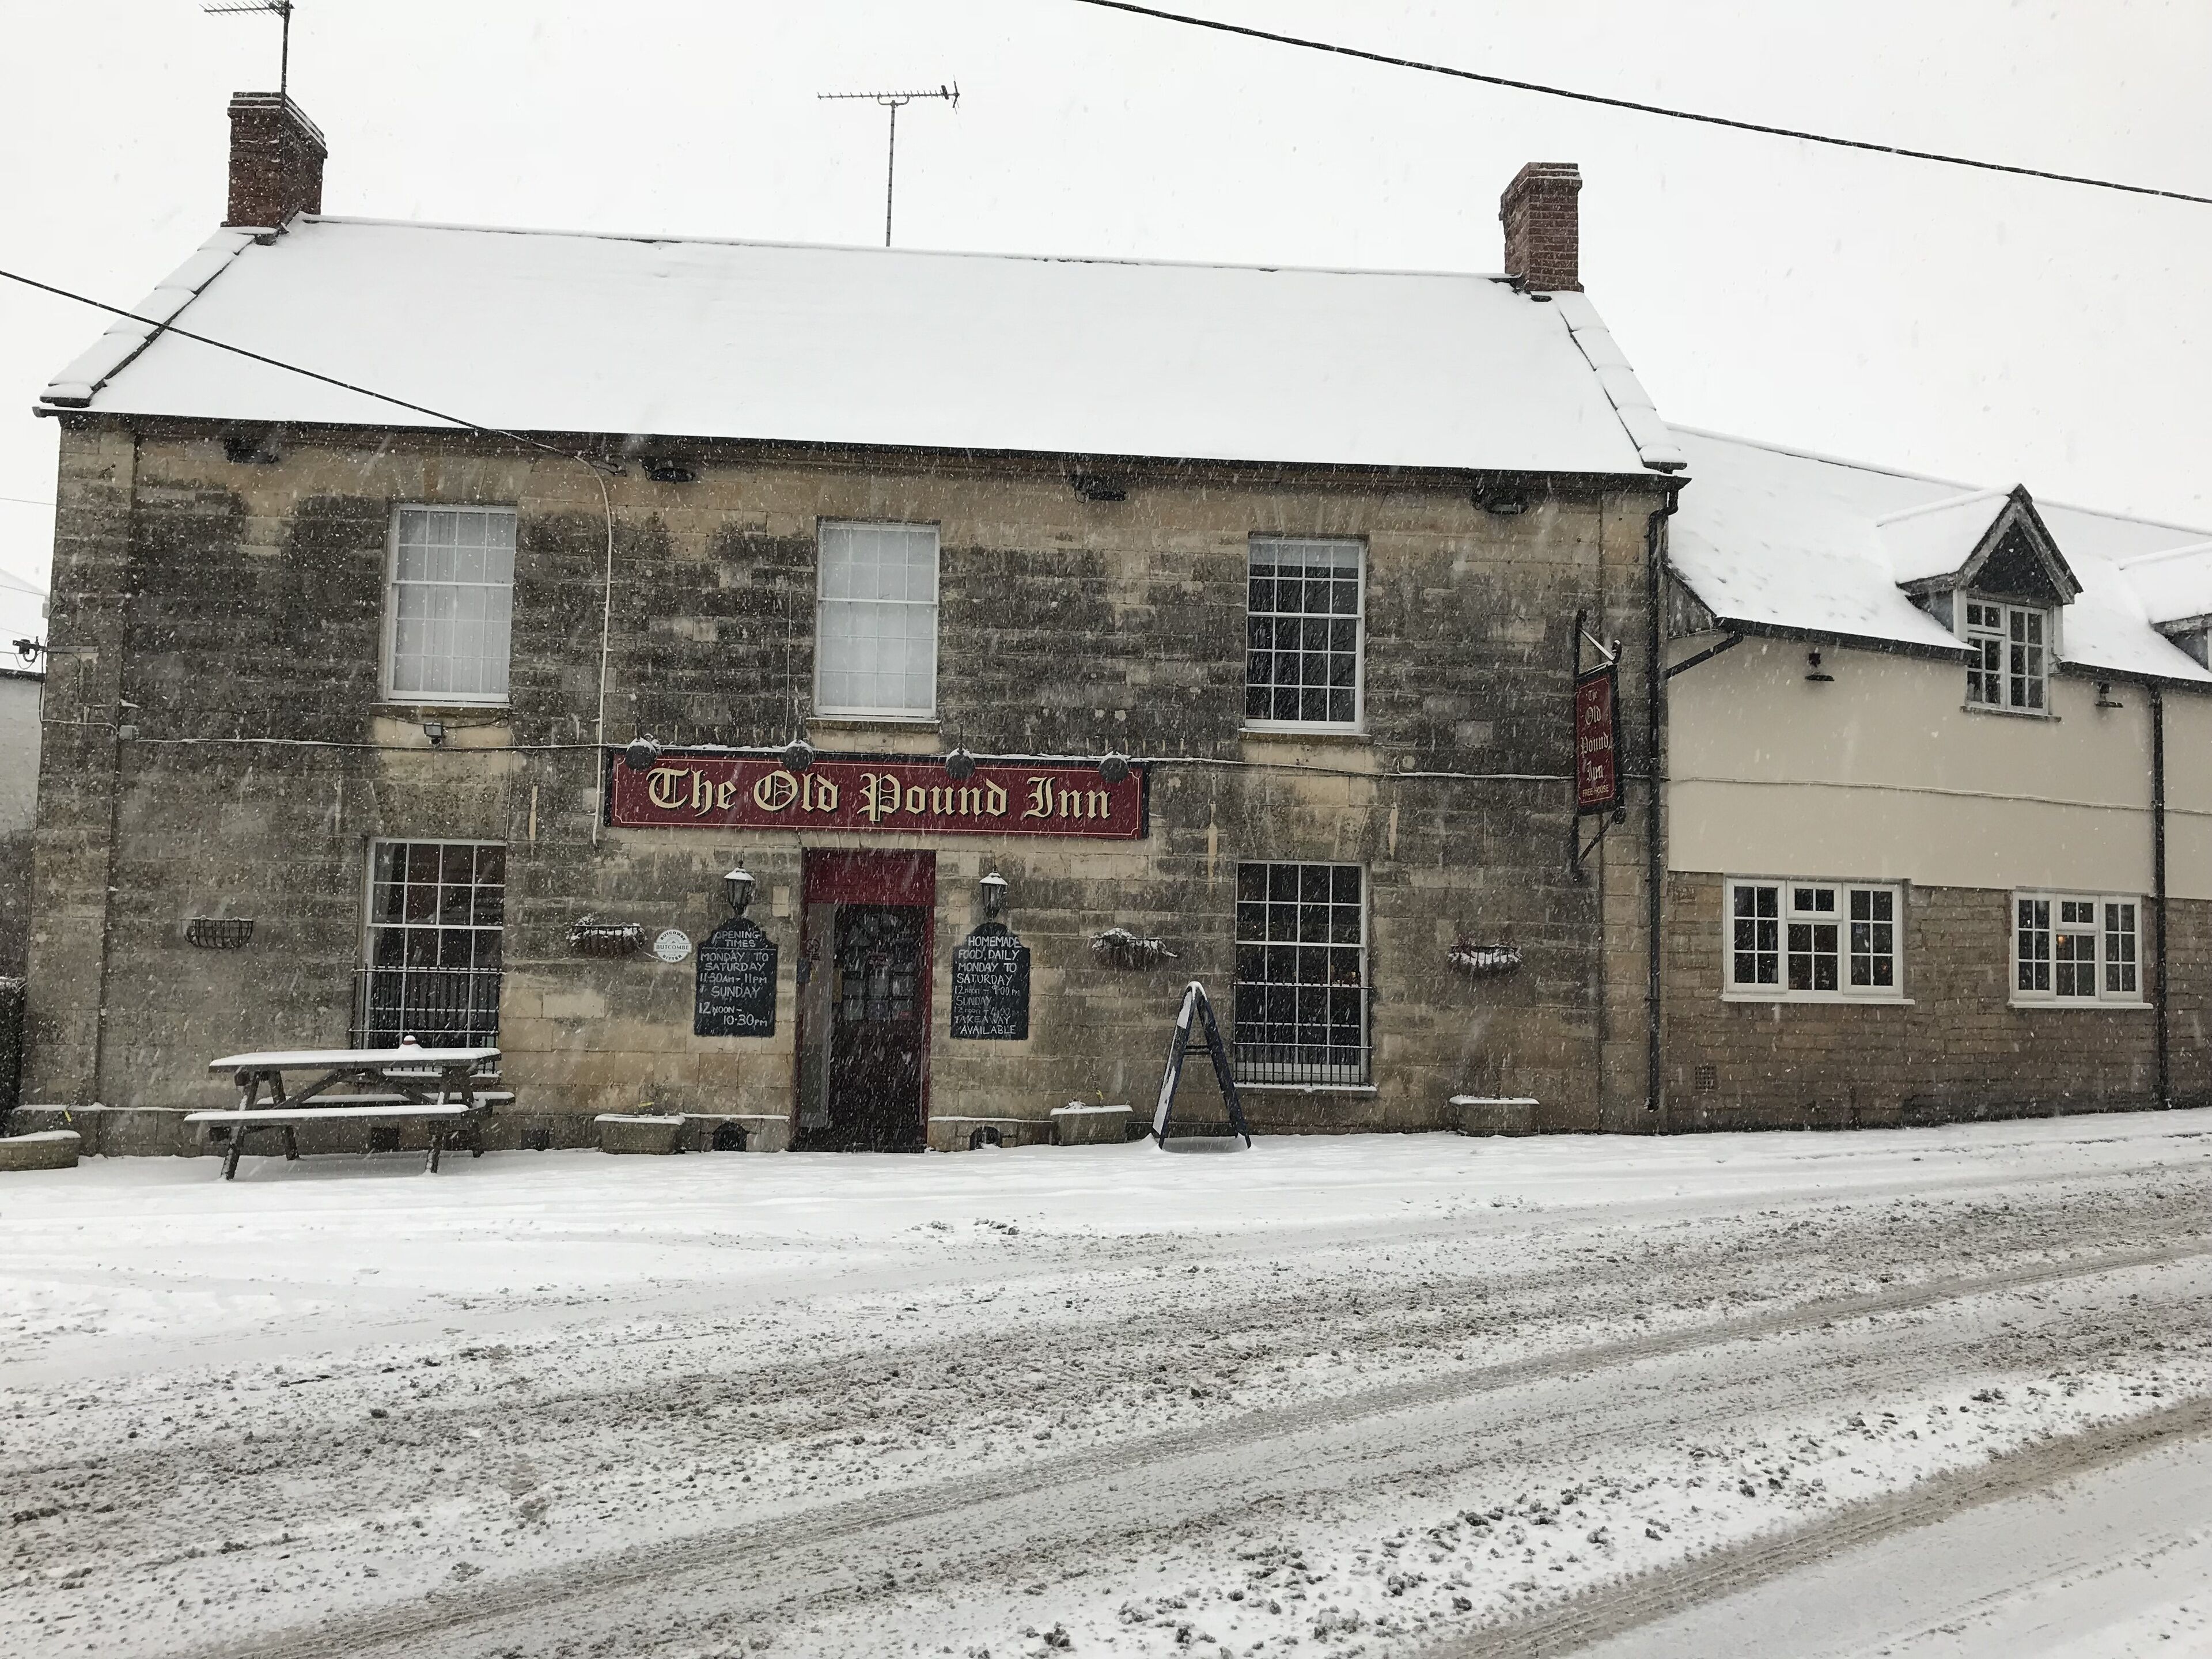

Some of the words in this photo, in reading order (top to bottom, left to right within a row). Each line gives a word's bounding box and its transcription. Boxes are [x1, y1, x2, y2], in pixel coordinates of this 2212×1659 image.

[1585, 705, 1601, 725] Old
[1580, 732, 1609, 758] Pound
[1586, 760, 1604, 781] Inn
[646, 768, 737, 817] The
[753, 770, 839, 813] Old
[857, 773, 1007, 821] Pound
[1024, 777, 1111, 819] Inn
[1582, 787, 1593, 797] FREE
[1594, 784, 1609, 794] HOUSE
[660, 931, 686, 941] BUTCOMBE
[715, 930, 760, 940] OPENING
[725, 940, 756, 948] TIMES
[968, 936, 1022, 948] HOMEMADE
[700, 952, 745, 962] MONDAY
[753, 952, 769, 962] TO
[704, 962, 766, 972] SATURDAY
[957, 962, 999, 972] MONDAY
[1003, 963, 1017, 972] TO
[745, 973, 767, 983] 11PM
[957, 972, 1013, 986] SATURDAY
[710, 986, 761, 998] SUNDAY
[956, 995, 992, 1006] SUNDAY
[954, 1014, 1011, 1024] TAKEAWAY
[960, 1025, 1017, 1035] AVAILABLE
